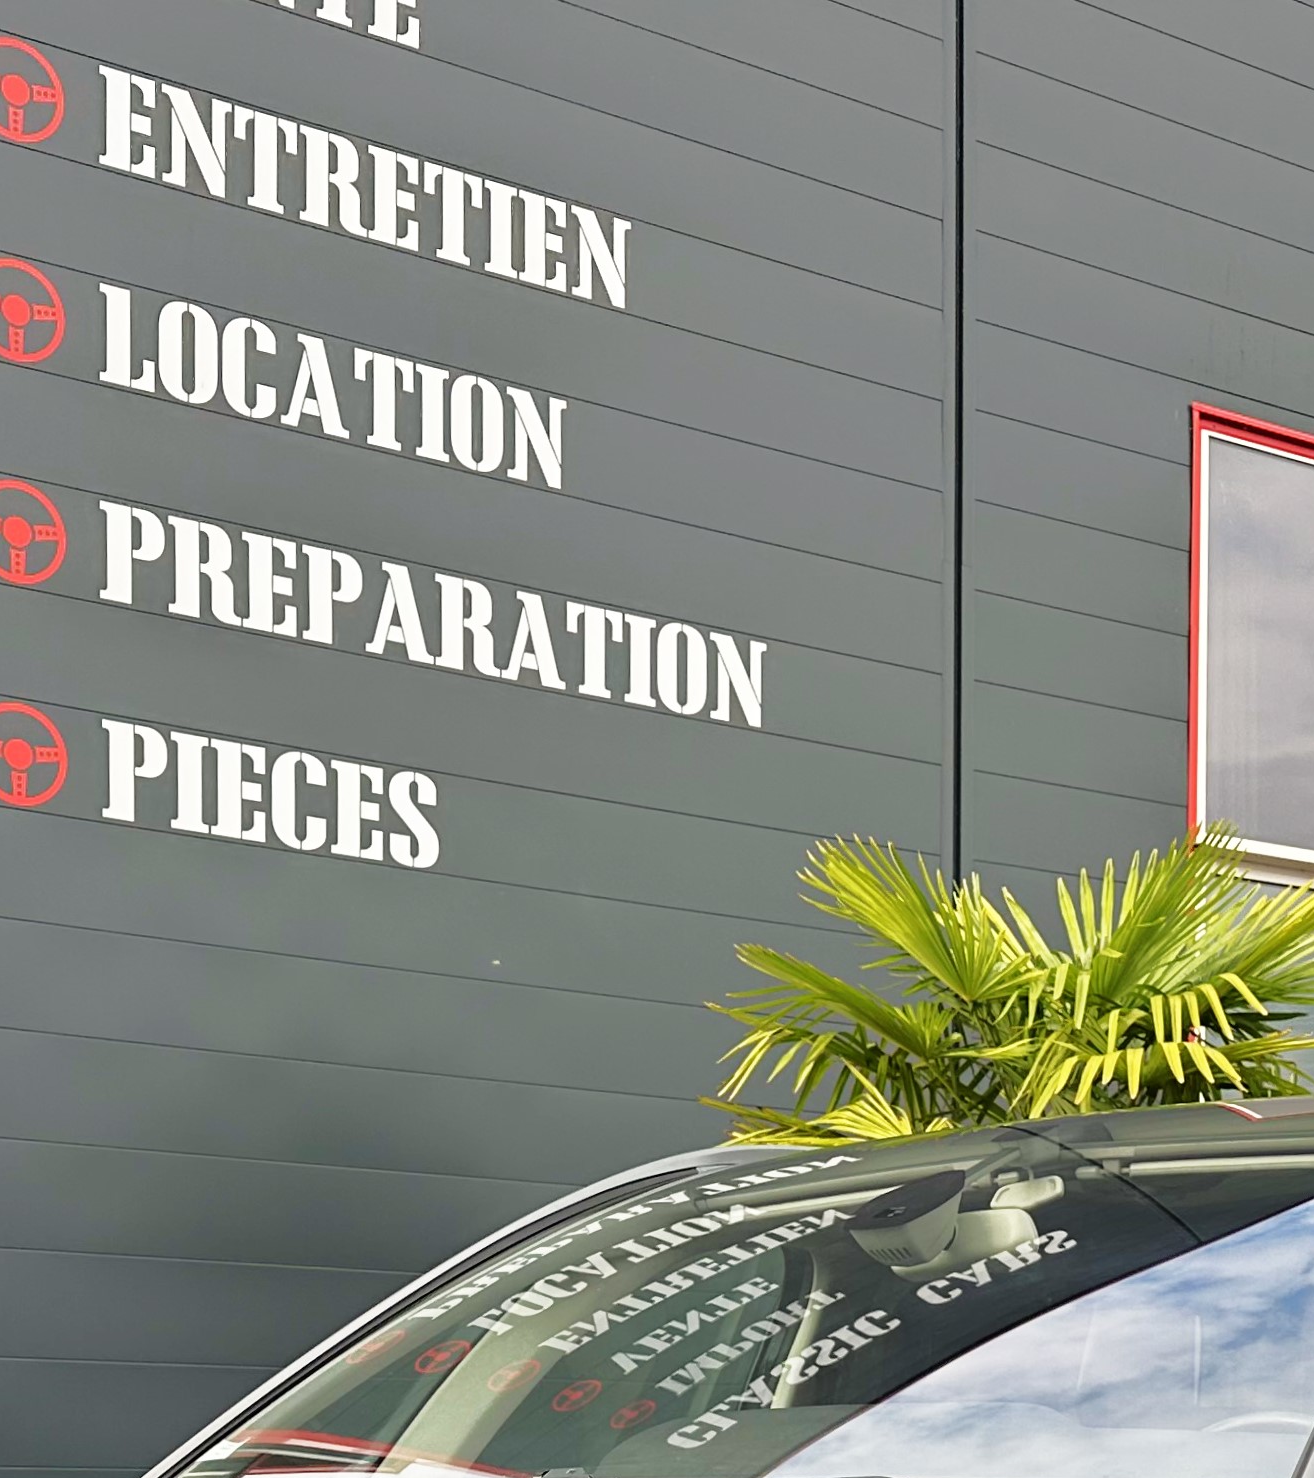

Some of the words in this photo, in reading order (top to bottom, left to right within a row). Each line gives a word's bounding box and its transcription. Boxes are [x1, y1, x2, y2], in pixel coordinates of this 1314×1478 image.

[99, 64, 632, 309] ENTRETIEN
[99, 282, 568, 490] LOCATION
[99, 500, 768, 728] PREPARATION
[101, 718, 440, 869] PIECES
